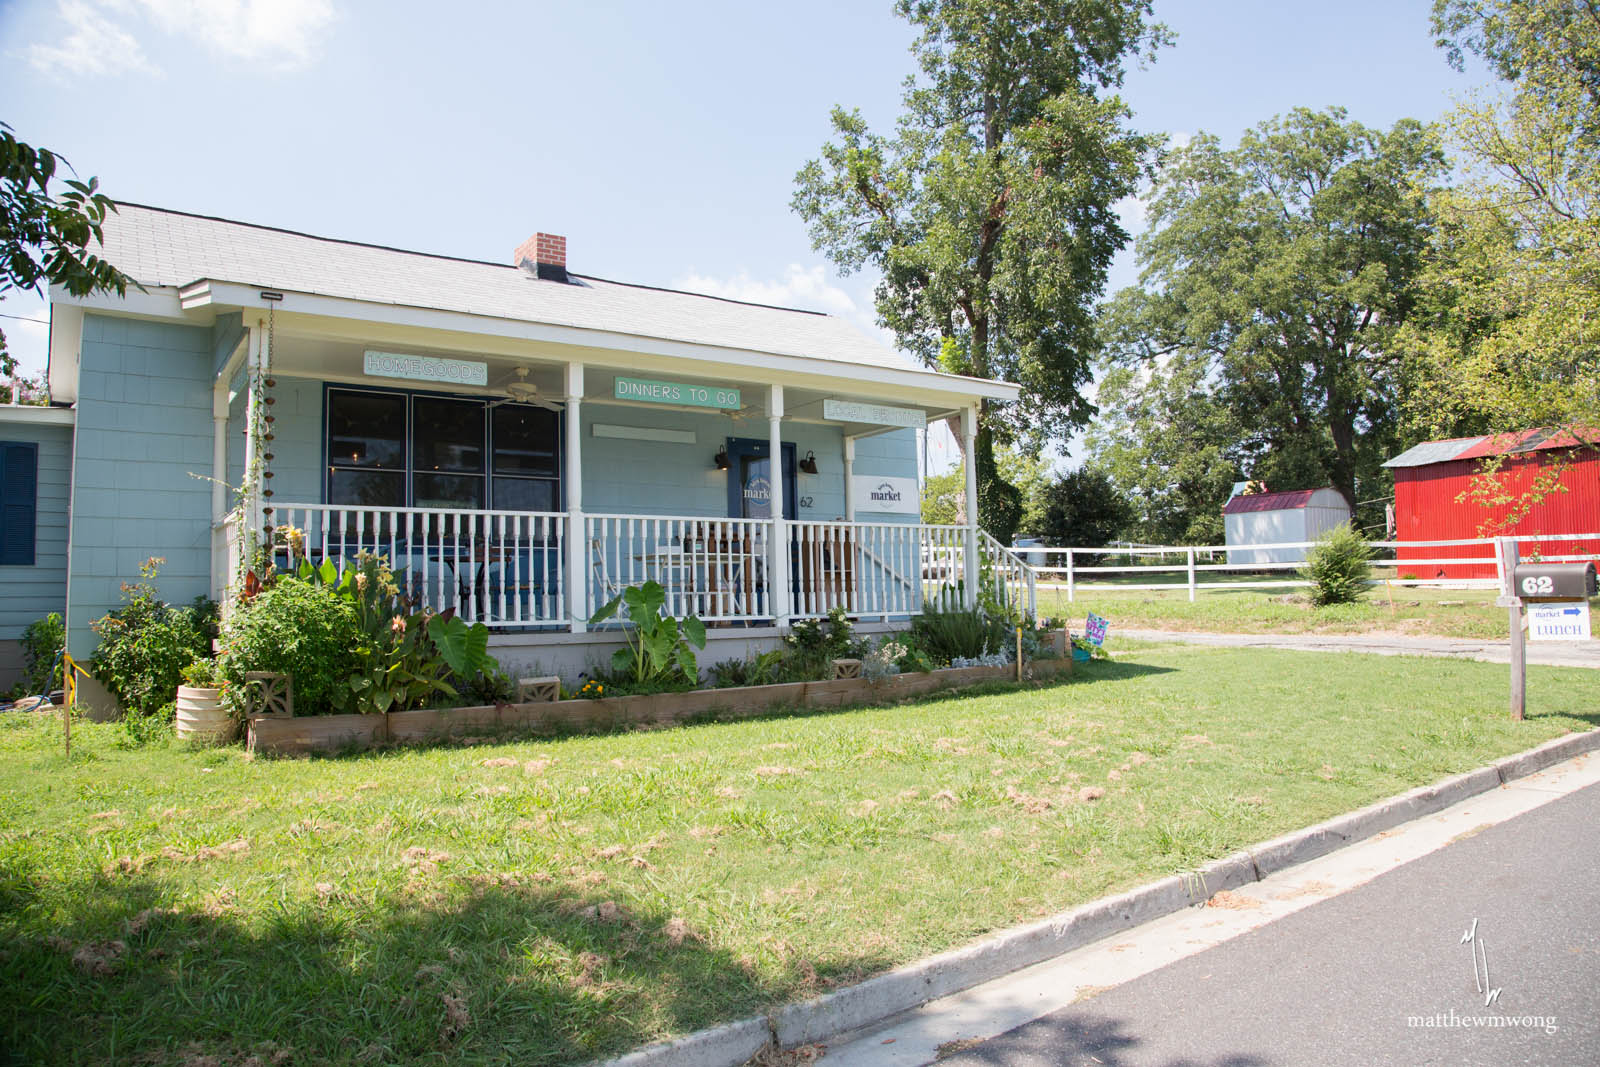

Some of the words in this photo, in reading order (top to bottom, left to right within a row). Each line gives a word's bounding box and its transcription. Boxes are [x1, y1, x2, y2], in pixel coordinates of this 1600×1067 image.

[618, 381, 680, 400] DINNERS
[689, 388, 708, 401] TO
[716, 391, 737, 405] GO
[743, 487, 770, 499] mark
[871, 490, 901, 501] market
[800, 496, 814, 508] 62
[1522, 576, 1554, 594] 62
[1535, 610, 1561, 618] market
